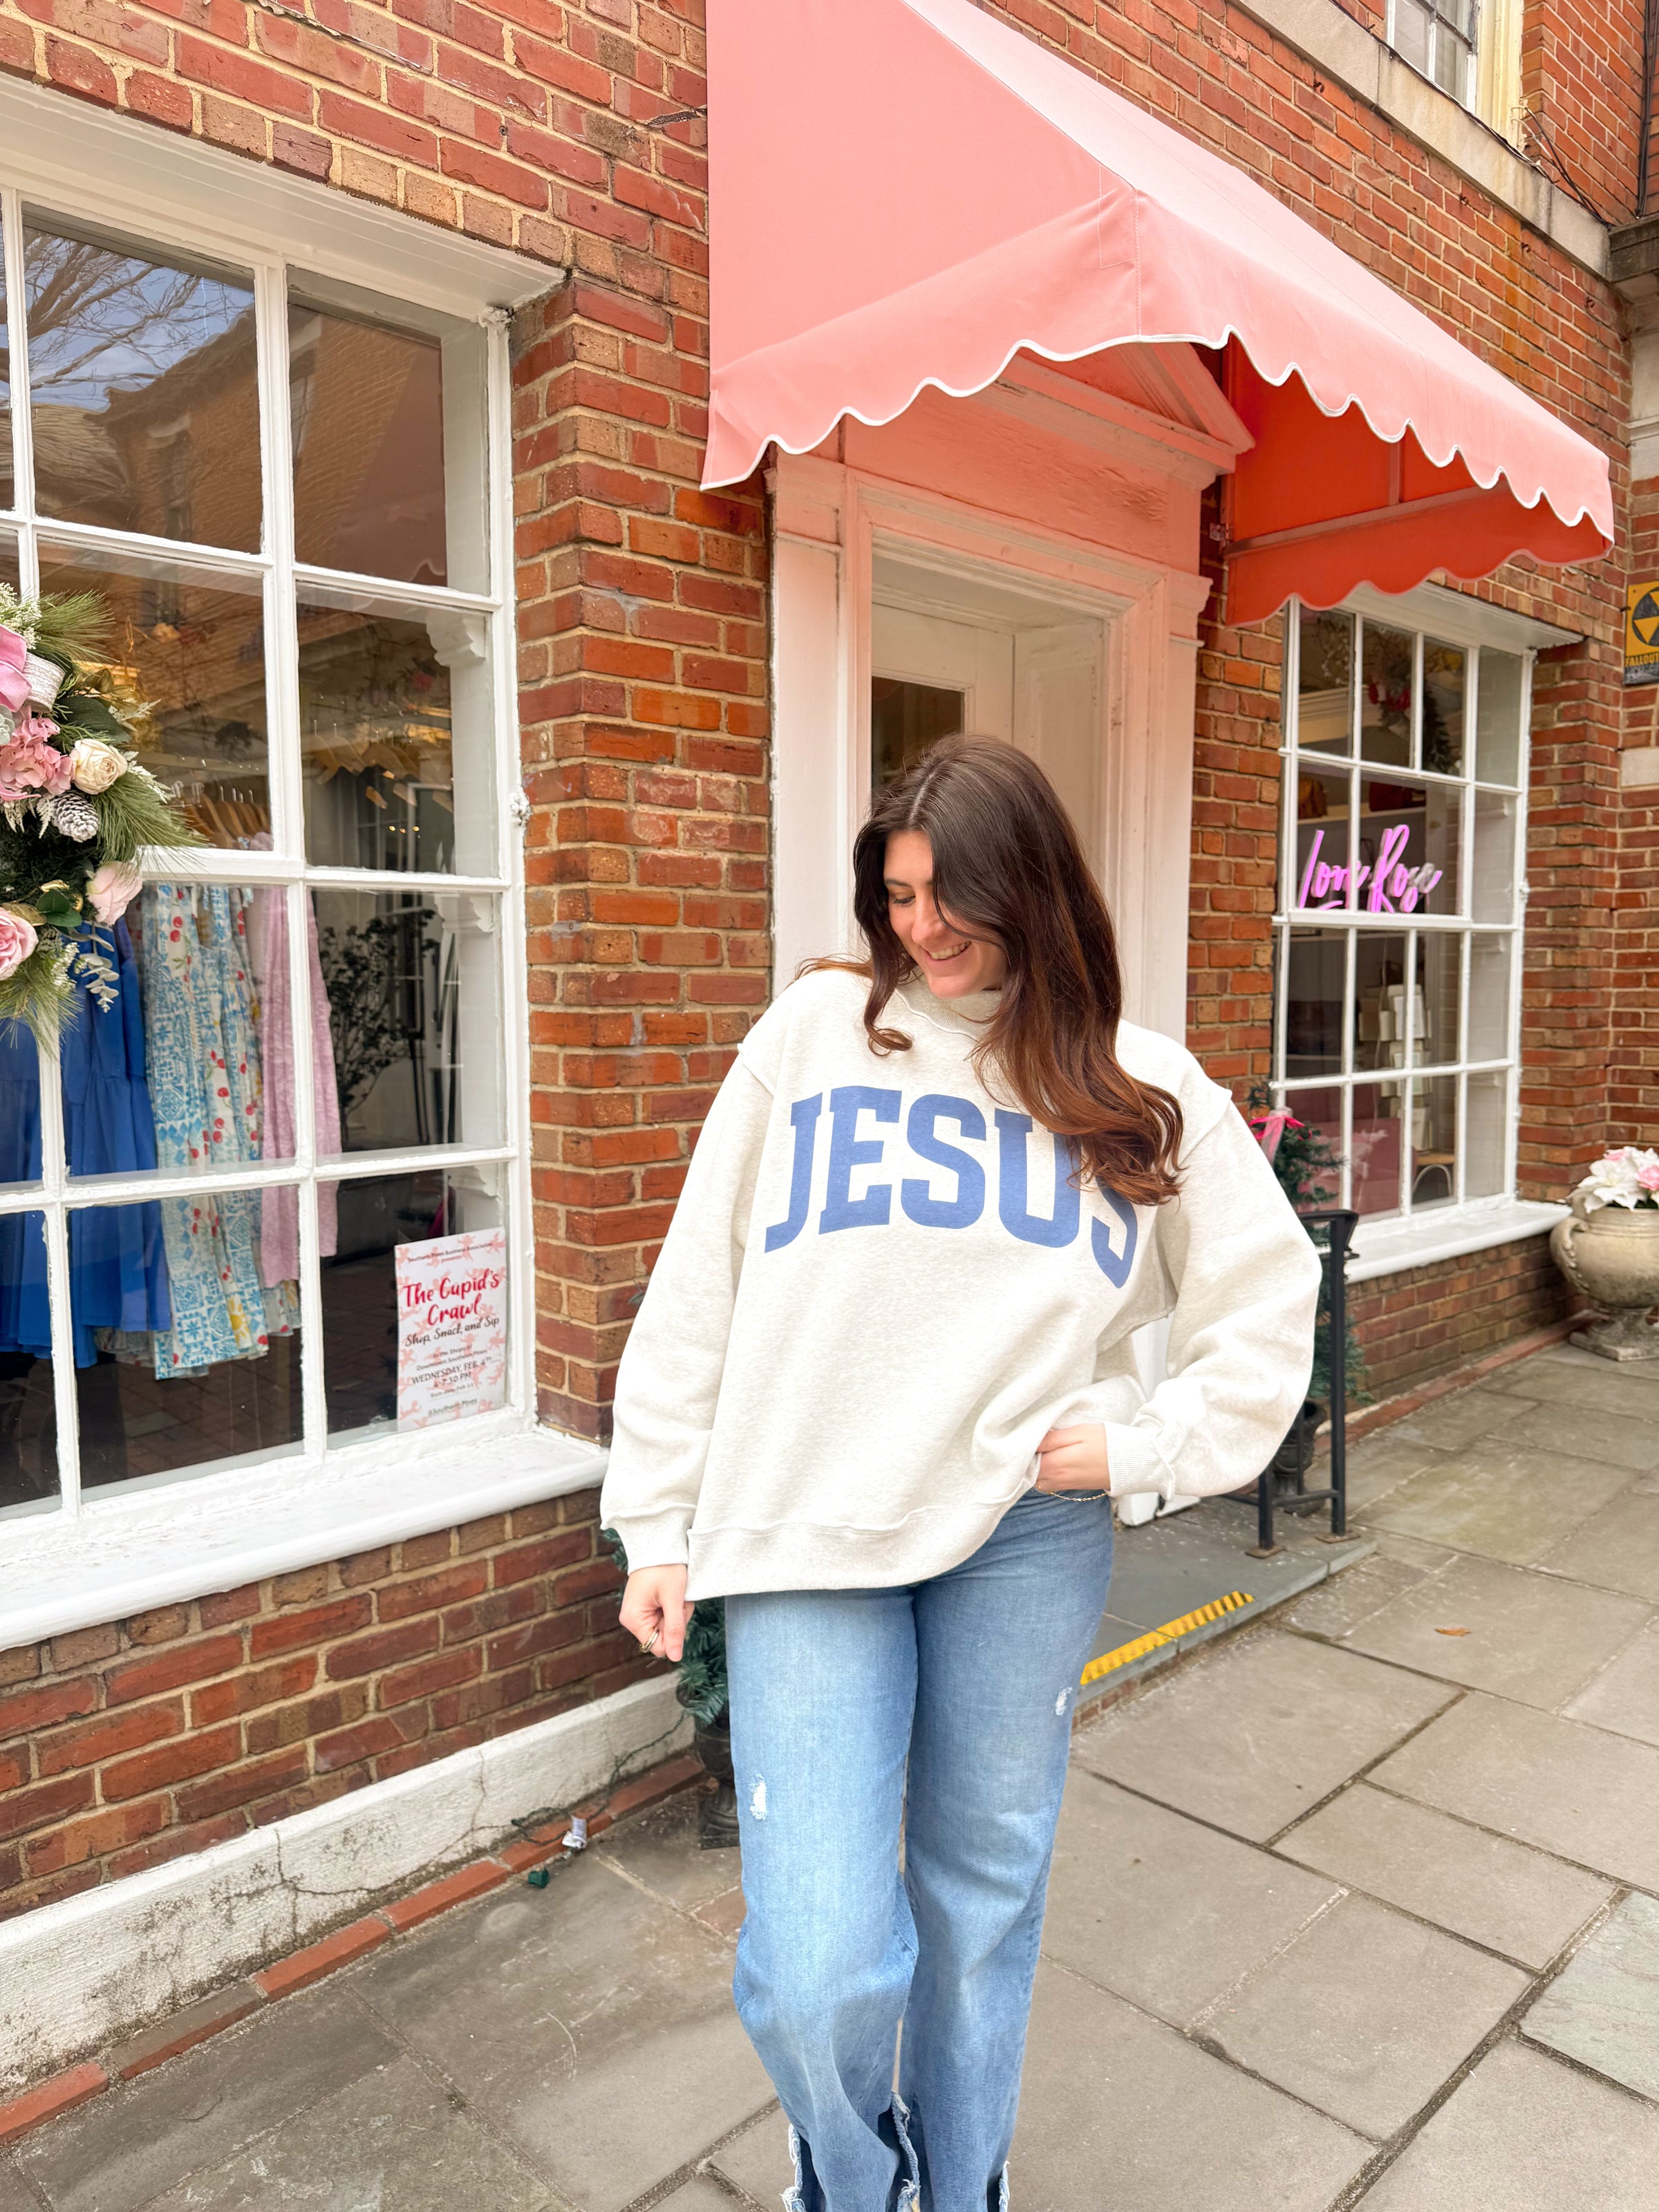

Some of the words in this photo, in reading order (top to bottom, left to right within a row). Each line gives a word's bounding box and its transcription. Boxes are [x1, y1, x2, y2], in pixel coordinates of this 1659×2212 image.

[402, 1282, 434, 1308] The
[439, 1268, 500, 1300] Cupid's
[427, 1293, 482, 1327] Crawl
[465, 1317, 484, 1332] and
[484, 1315, 500, 1328] Sip
